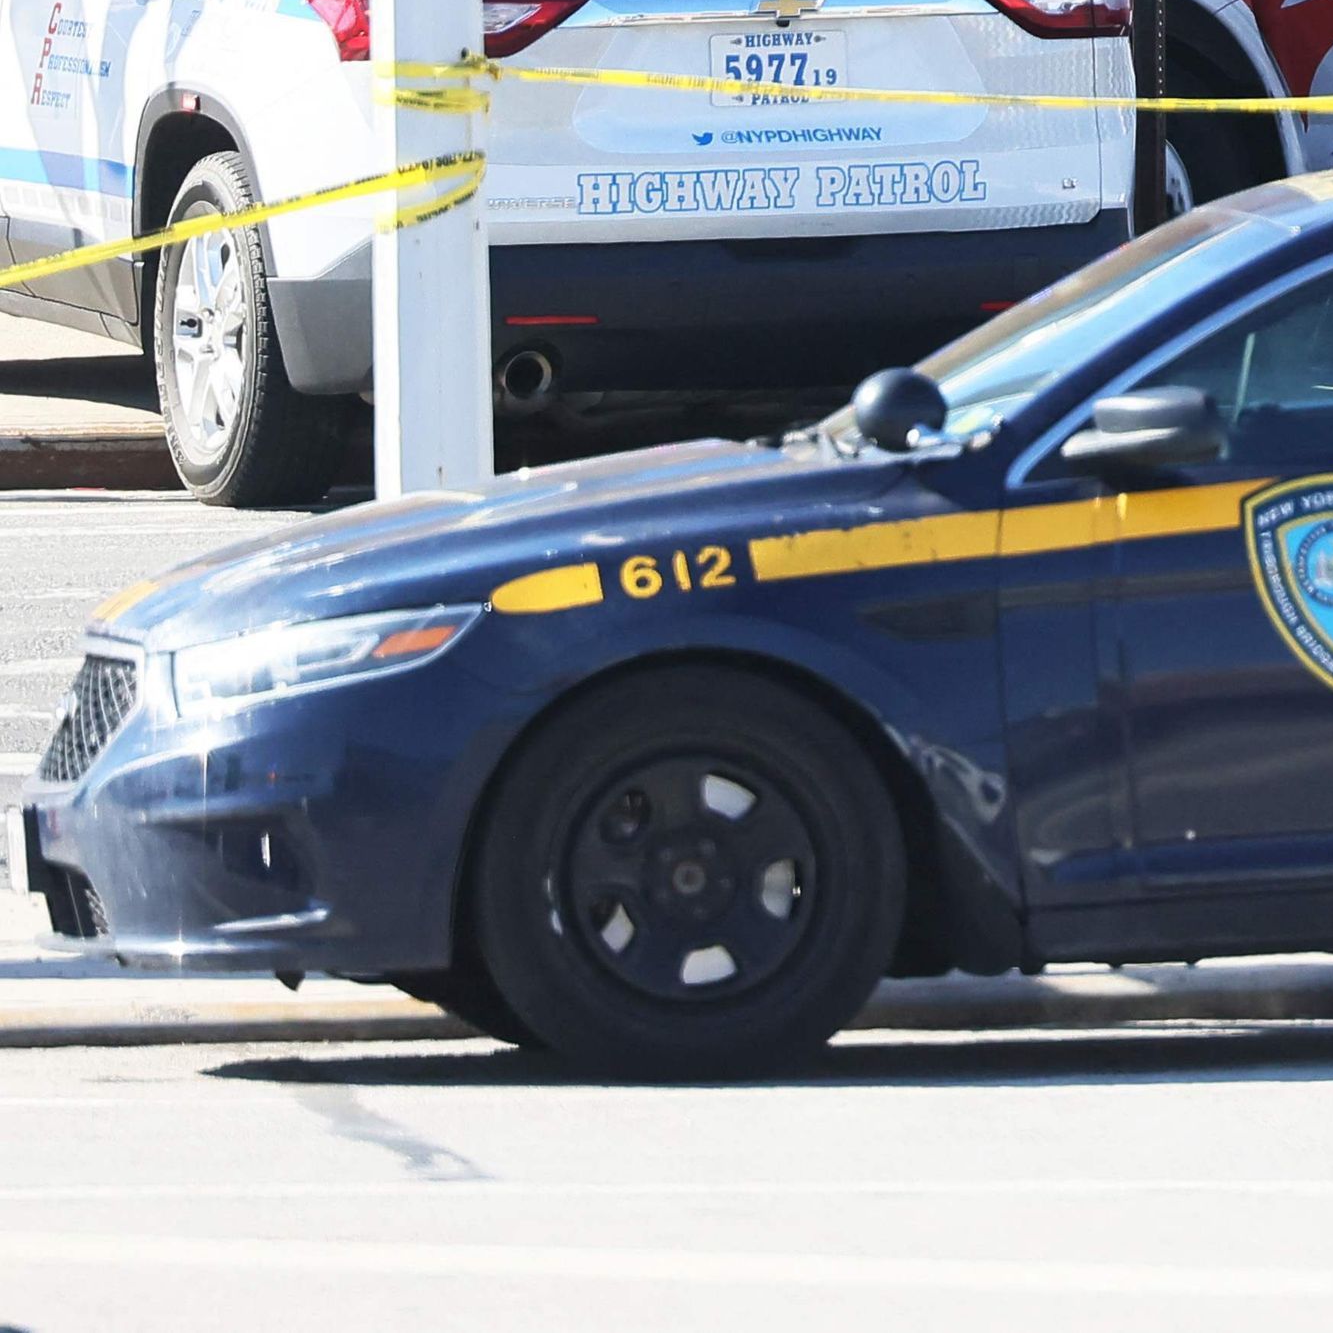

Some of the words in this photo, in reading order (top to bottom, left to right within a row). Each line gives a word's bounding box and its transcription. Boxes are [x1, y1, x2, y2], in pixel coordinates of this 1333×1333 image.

[744, 32, 814, 48] HIGHWAY
[724, 52, 808, 88] 5977
[813, 68, 838, 87] 19
[721, 126, 883, 145] @NYPDHIGHWAY
[577, 166, 801, 216] HIGHWAY
[815, 159, 988, 207] PATROL
[1257, 500, 1295, 527] NEW
[618, 543, 736, 601] 612
